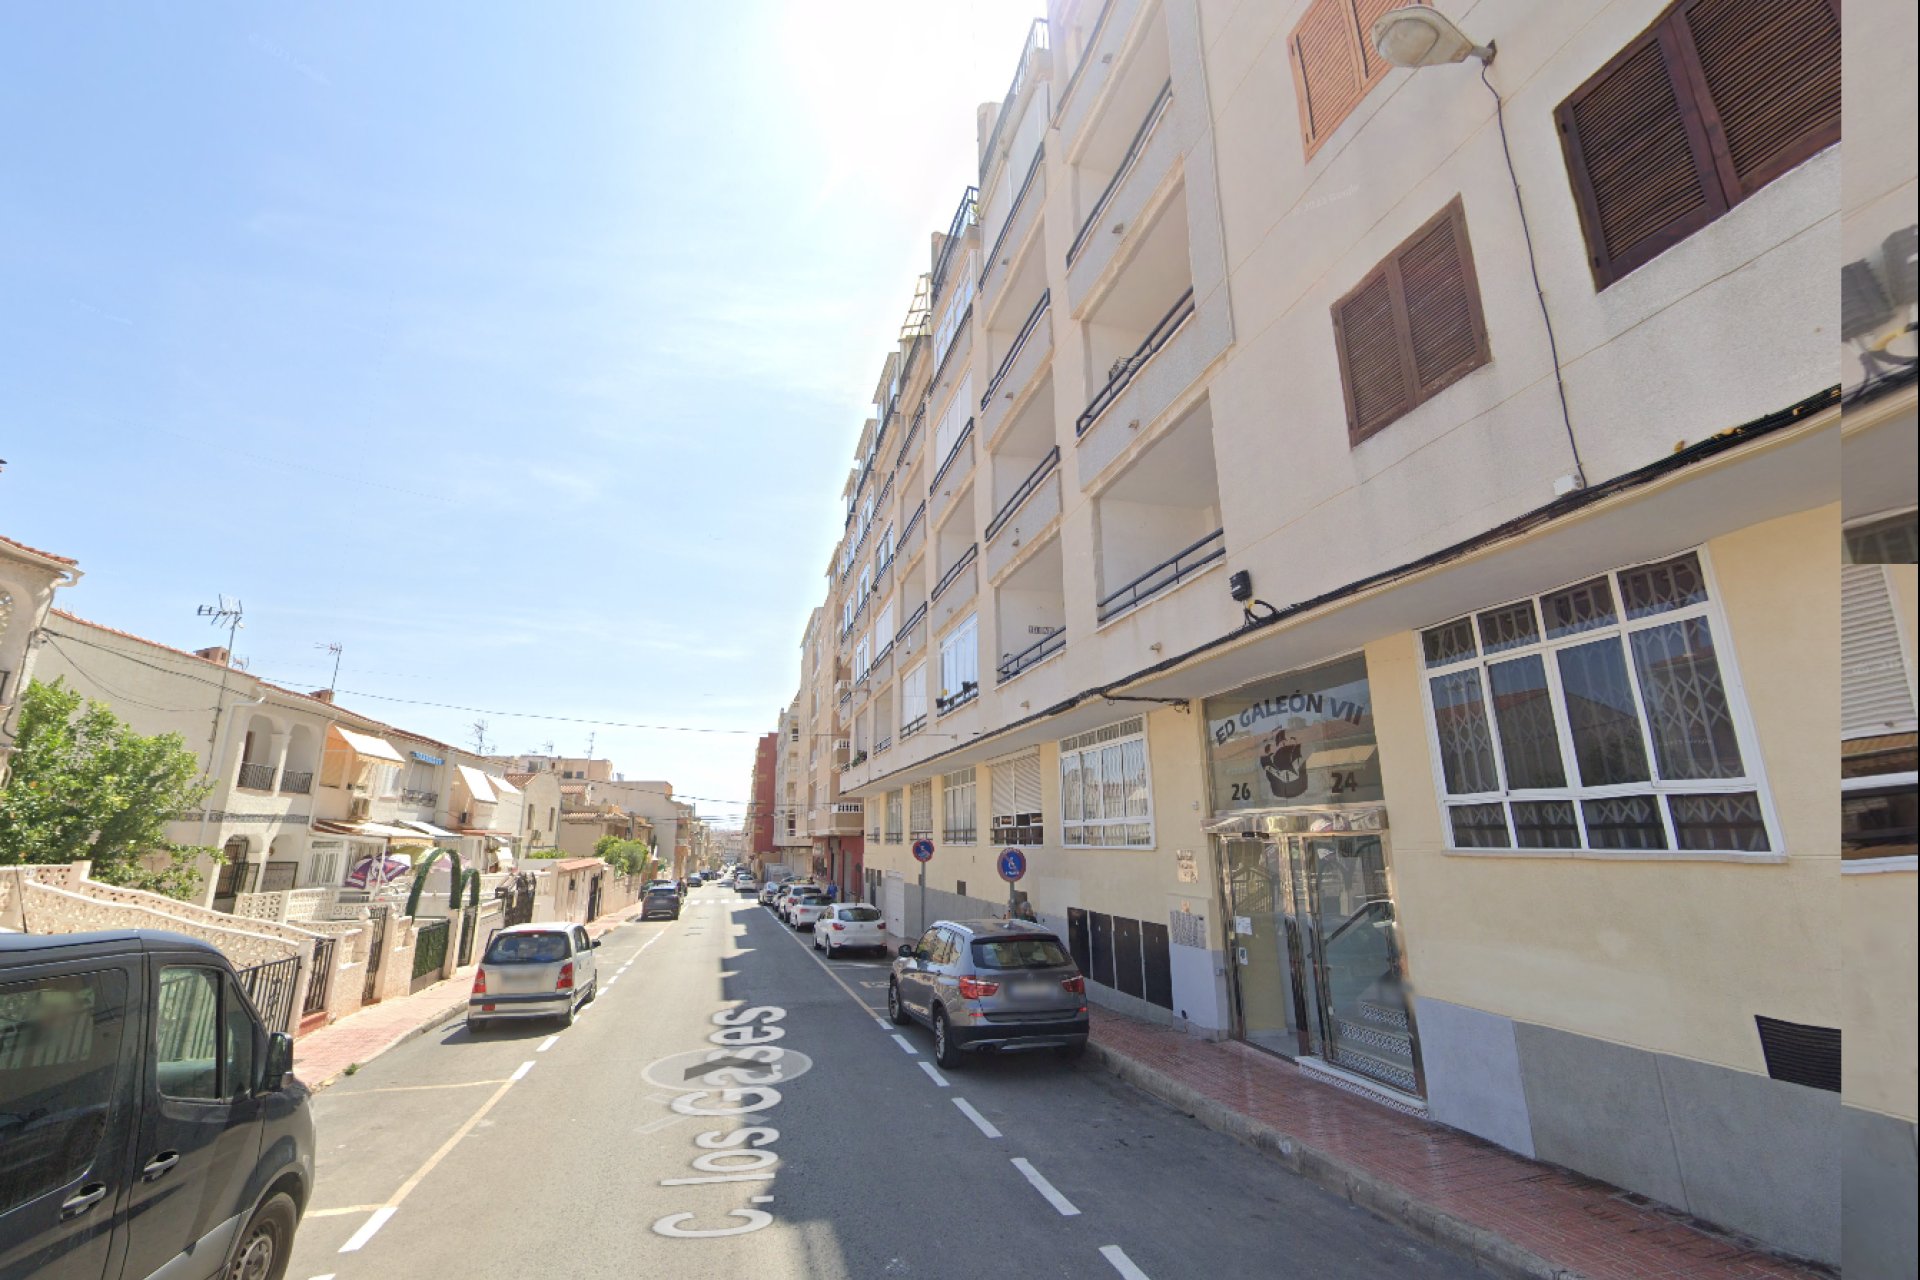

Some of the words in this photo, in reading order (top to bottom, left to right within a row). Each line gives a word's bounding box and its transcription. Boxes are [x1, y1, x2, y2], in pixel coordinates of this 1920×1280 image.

[1216, 719, 1236, 746] ED
[1239, 690, 1323, 728] GALEÓN
[1329, 697, 1365, 726] VII
[1231, 782, 1251, 801] 26
[1331, 772, 1358, 793] 24
